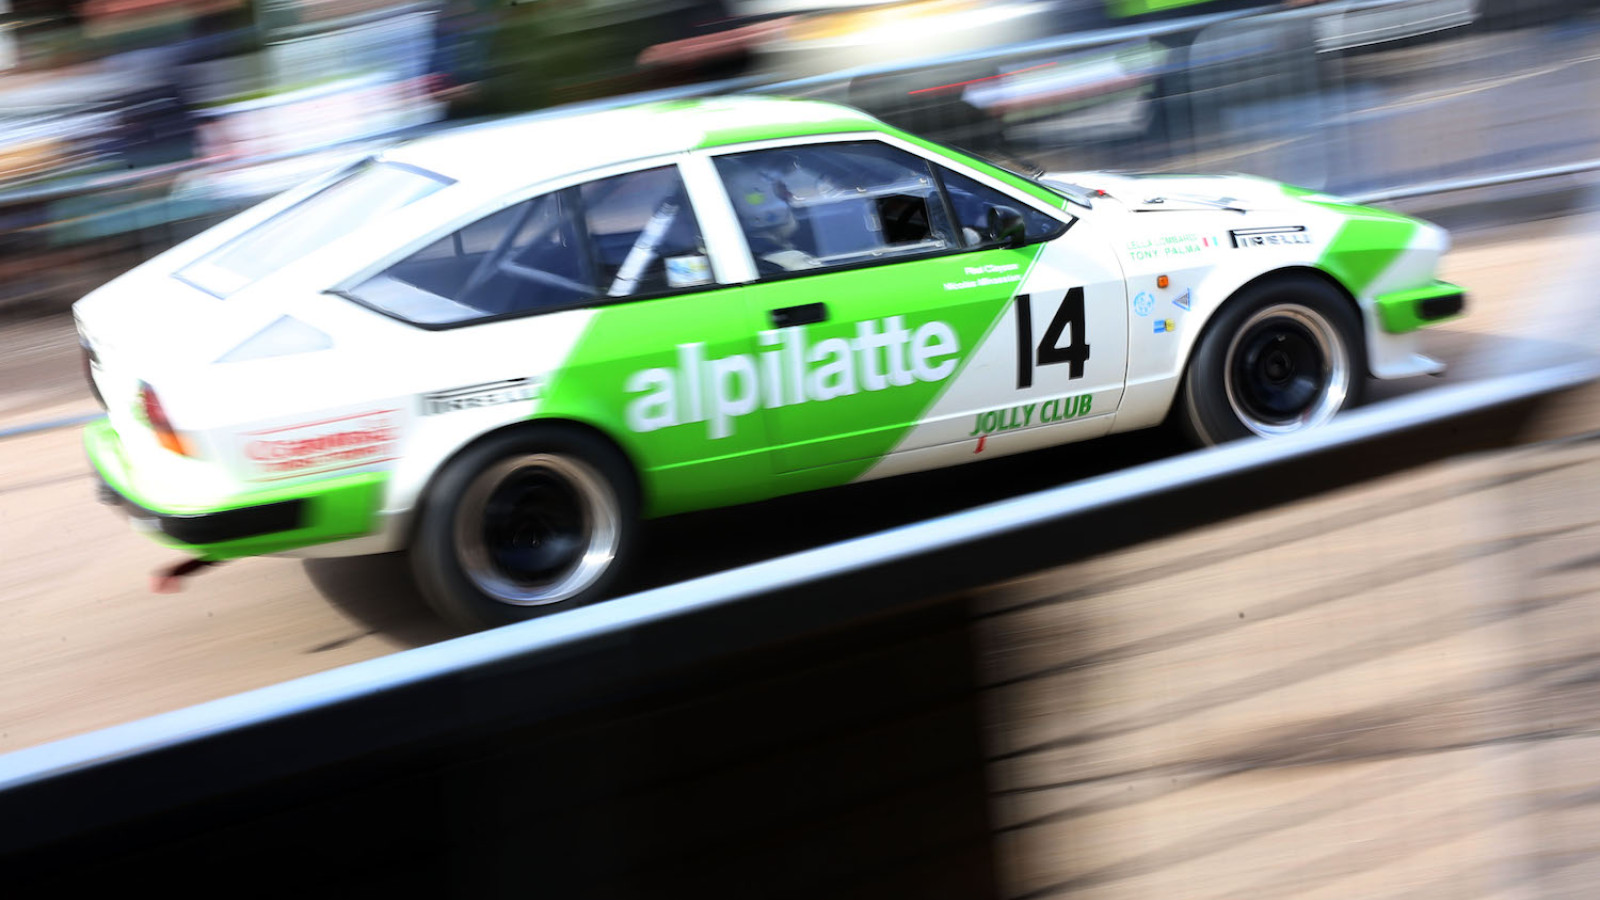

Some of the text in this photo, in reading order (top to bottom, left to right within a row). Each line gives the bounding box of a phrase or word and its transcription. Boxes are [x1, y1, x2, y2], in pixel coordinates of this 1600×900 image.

[1129, 244, 1201, 261] TONY PALMA
[1226, 225, 1310, 249] PIRELLI
[1014, 286, 1090, 390] 14
[623, 315, 961, 439] alpilatte
[970, 393, 1093, 436] JOLLY CLUB
